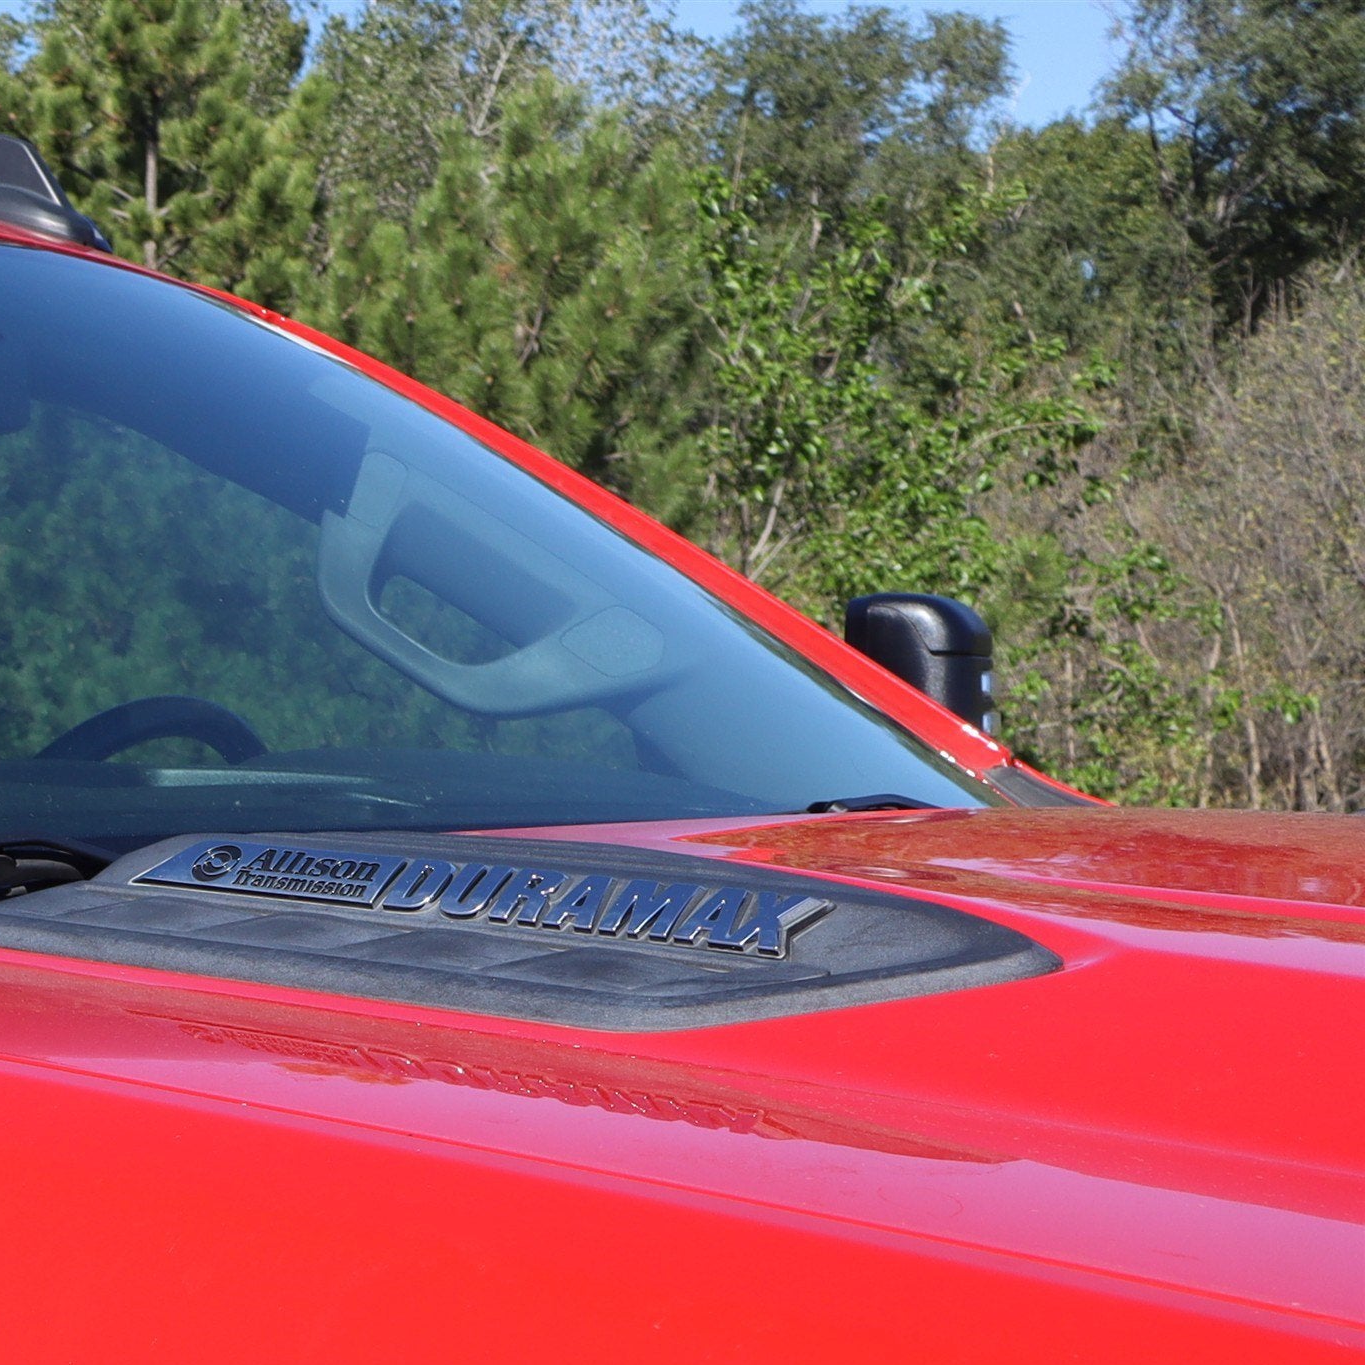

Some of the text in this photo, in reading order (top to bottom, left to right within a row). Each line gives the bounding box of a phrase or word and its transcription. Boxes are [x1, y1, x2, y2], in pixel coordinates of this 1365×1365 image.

[241, 848, 381, 882] Allison
[232, 868, 368, 898] Transmission
[381, 855, 835, 959] DURAMAX
